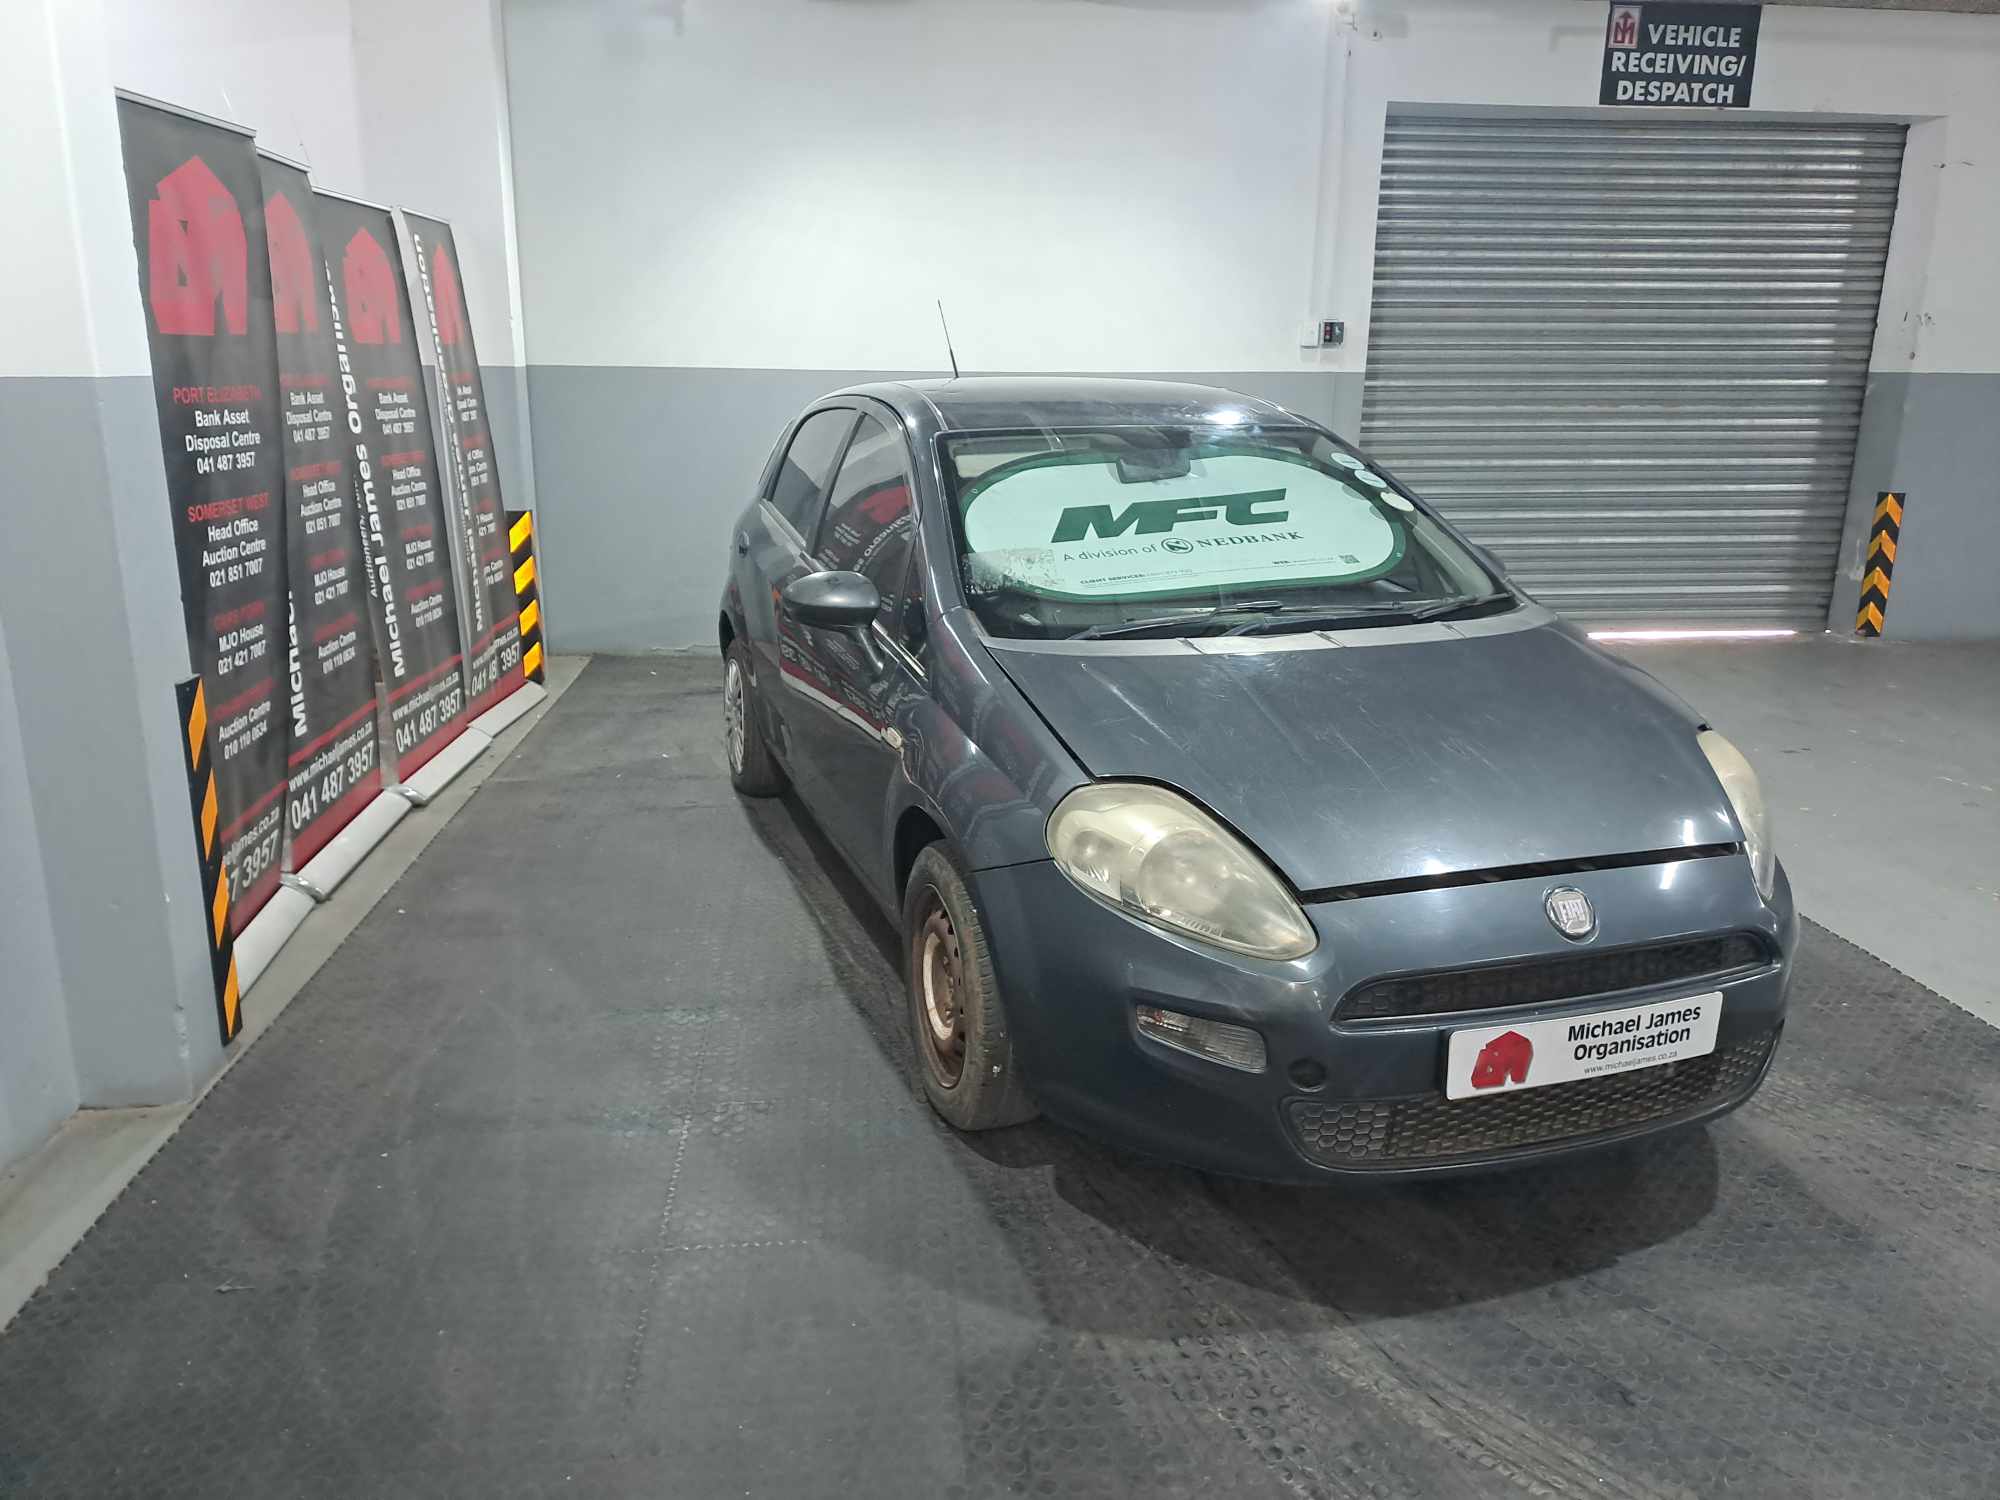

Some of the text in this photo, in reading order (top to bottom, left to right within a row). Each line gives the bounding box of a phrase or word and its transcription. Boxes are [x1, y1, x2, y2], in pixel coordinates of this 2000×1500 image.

[1648, 23, 1742, 48] VEHICLE
[1611, 51, 1747, 77] RECEIVING/
[1616, 80, 1735, 104] DESPATCH
[173, 387, 203, 404] PORT
[195, 408, 250, 427] Bank Asset
[185, 431, 261, 454] Disposal Centre
[196, 452, 255, 474] 041 487 3957
[187, 497, 243, 522] SOMERSET
[356, 443, 384, 547] James
[208, 518, 259, 542] Head Office
[1050, 487, 1290, 544] MFC
[202, 539, 267, 567] Auction Centre
[1063, 530, 1304, 562] A division of NEDBANK
[209, 557, 263, 588] 021 851 7007
[375, 556, 405, 678] Michael
[219, 623, 264, 652] MJO House
[217, 656, 233, 676] 021
[234, 648, 249, 667] 421
[471, 668, 487, 697] 041
[500, 641, 520, 672] 3957
[218, 701, 271, 743] Auction Centre
[395, 688, 461, 753] 041 487 3957
[291, 740, 375, 830] 041 487 3957
[242, 829, 279, 888] 3957
[1568, 1006, 1701, 1042] Michael James
[1574, 1028, 1691, 1061] Organisation
[1584, 1051, 1678, 1075] www.michaeljames.co.za
